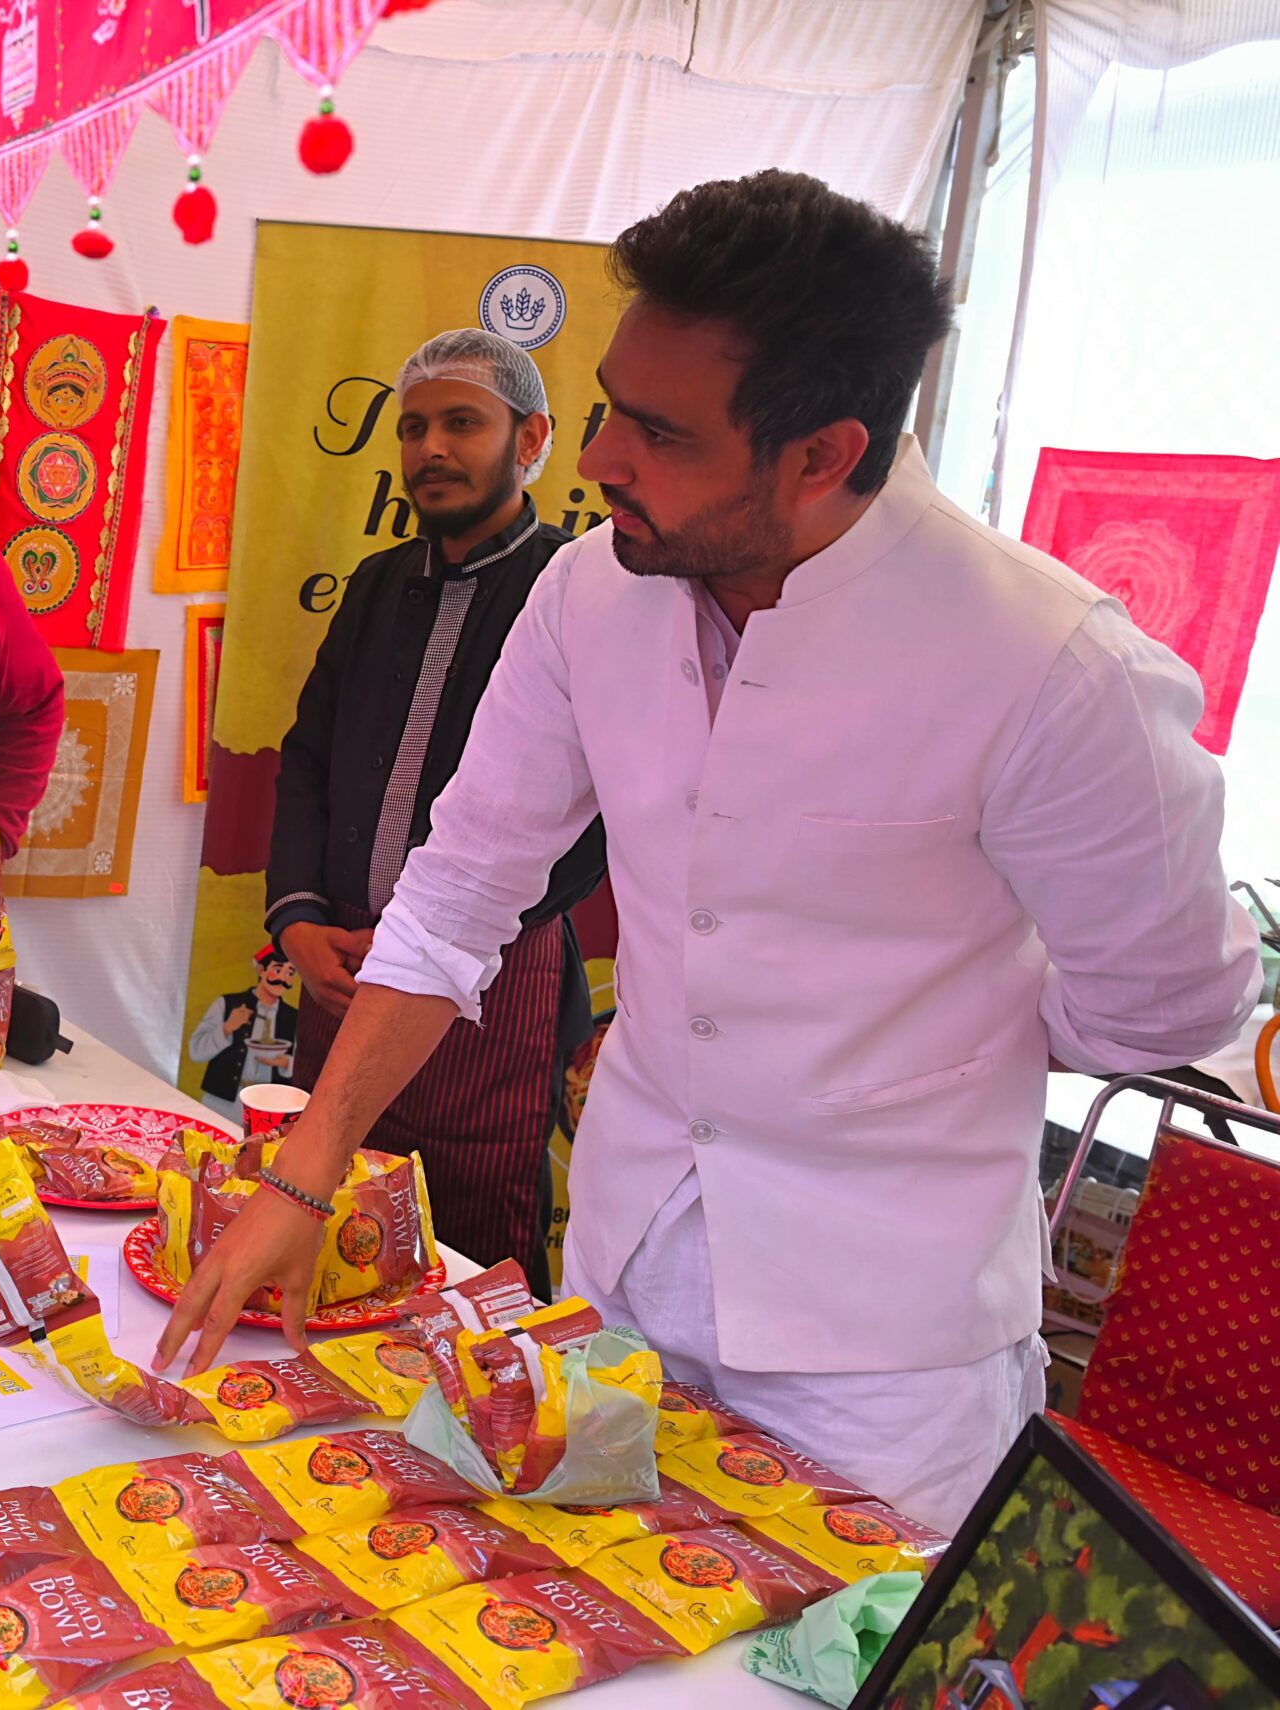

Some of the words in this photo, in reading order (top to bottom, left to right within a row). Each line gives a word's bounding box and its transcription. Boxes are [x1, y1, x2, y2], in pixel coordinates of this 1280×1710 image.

[389, 1190, 411, 1257] BOWL
[268, 1359, 320, 1398] BOWL
[184, 1464, 232, 1515] BOWL
[3, 1500, 43, 1543] PAHADI
[238, 1543, 300, 1591] BOWL
[709, 1529, 784, 1578] BOWL
[29, 1577, 83, 1648] BOWL
[53, 1575, 107, 1640] PAHADI
[533, 1581, 611, 1636] BOWL
[556, 1580, 628, 1634] PAHADI
[341, 1636, 412, 1700] BOWL
